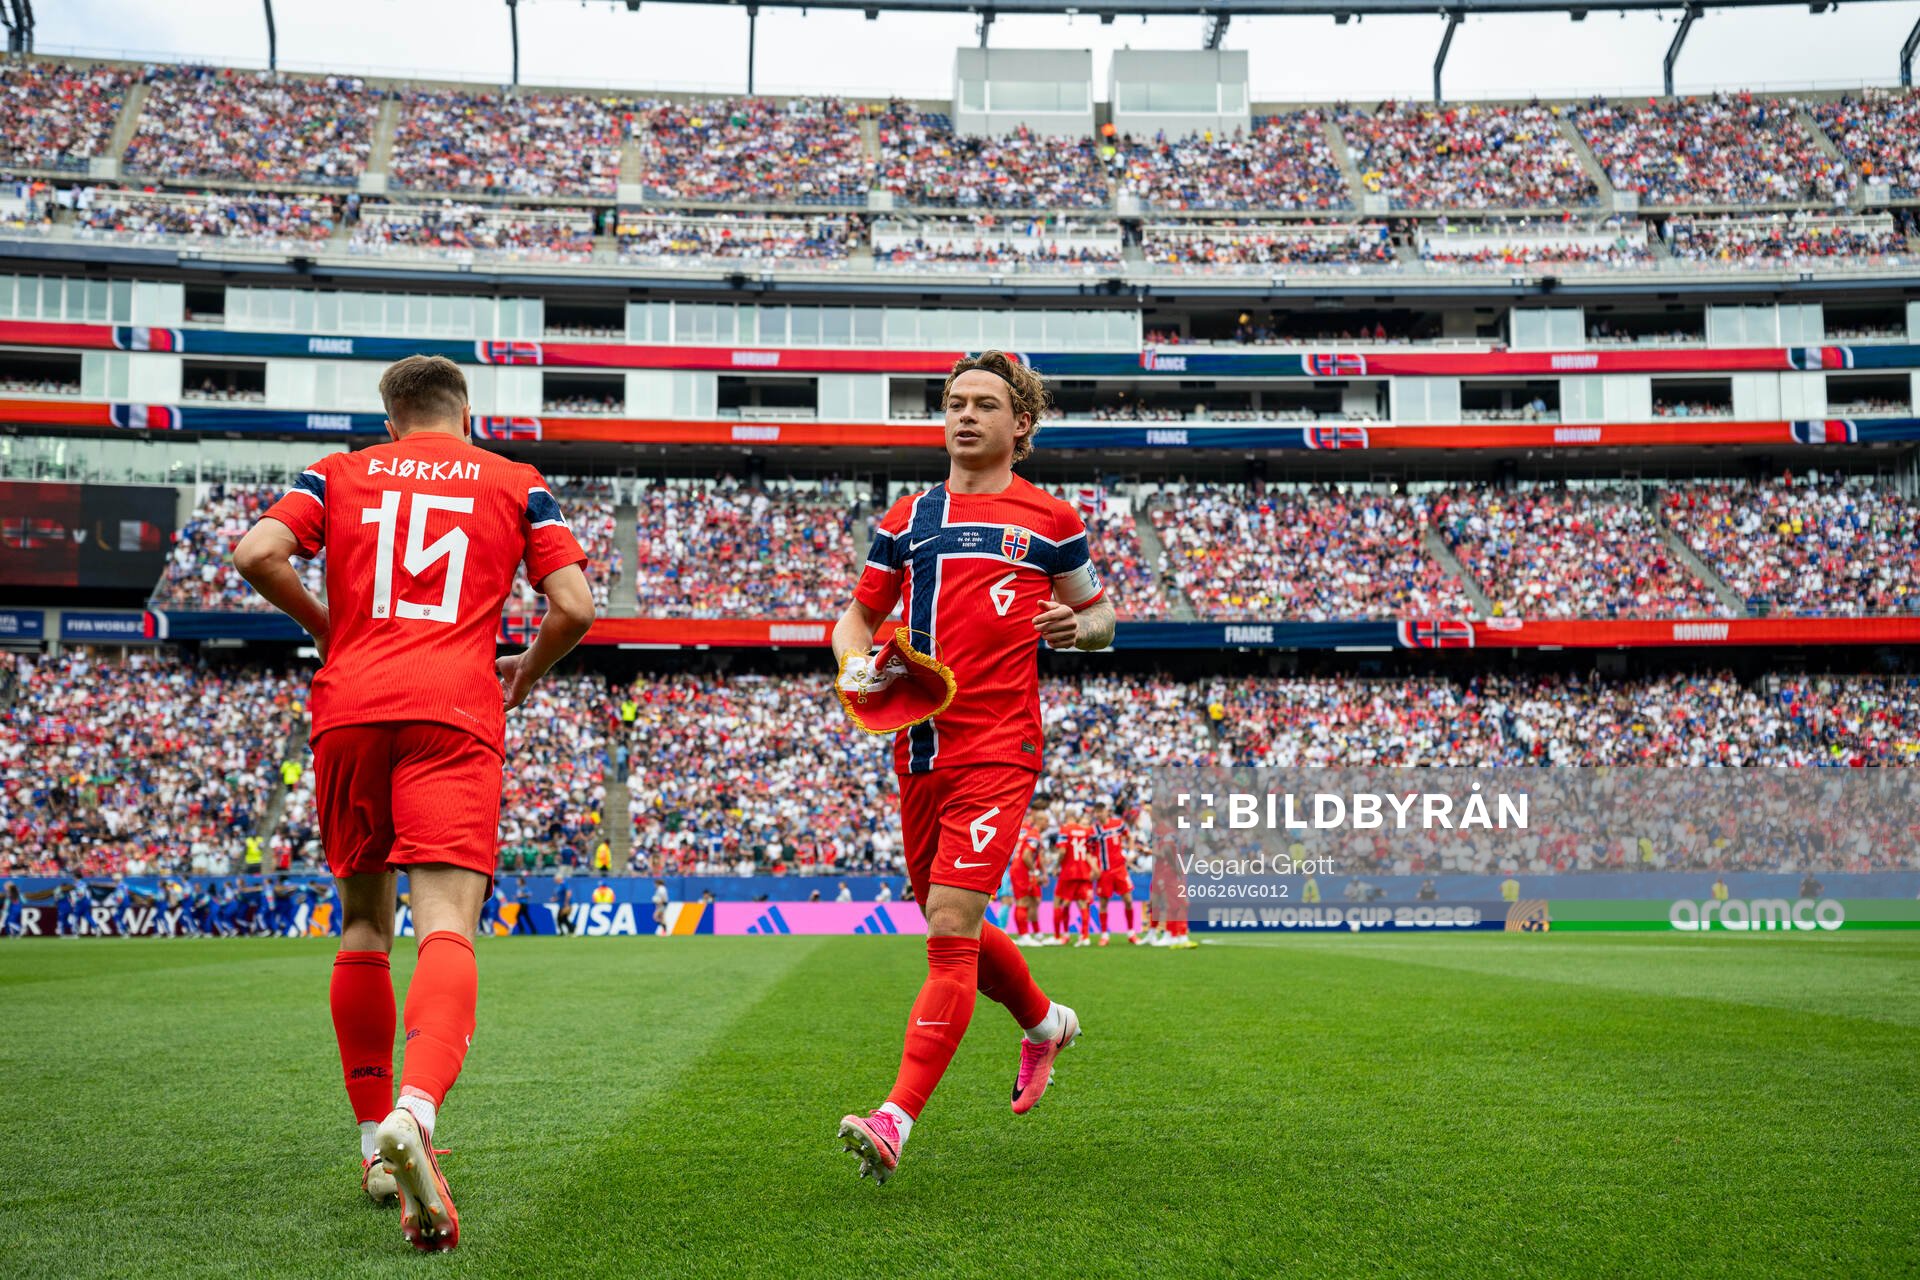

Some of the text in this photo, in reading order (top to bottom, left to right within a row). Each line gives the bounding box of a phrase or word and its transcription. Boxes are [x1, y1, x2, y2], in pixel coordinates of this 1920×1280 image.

[308, 338, 353, 353] FRANCE
[1551, 354, 1598, 369] NORWAY
[307, 414, 352, 430] FRANCE
[1147, 430, 1188, 444] FRANCE
[1554, 427, 1601, 442] NORWAY
[367, 457, 481, 480] BJØRKAN
[361, 490, 475, 624] 15
[989, 572, 1017, 616] 6
[67, 620, 91, 631] FIFA
[95, 621, 135, 632] WORLD
[769, 624, 826, 641] NORWAY
[1225, 626, 1274, 643] FRANCE
[1673, 623, 1729, 641] NORWAY
[970, 806, 1000, 853] 6
[1208, 907, 1258, 927] FIFA
[1260, 907, 1343, 927] WORLD
[1346, 907, 1392, 927] CUP
[1394, 906, 1474, 927] 2026
[1669, 899, 1845, 930] aramco
